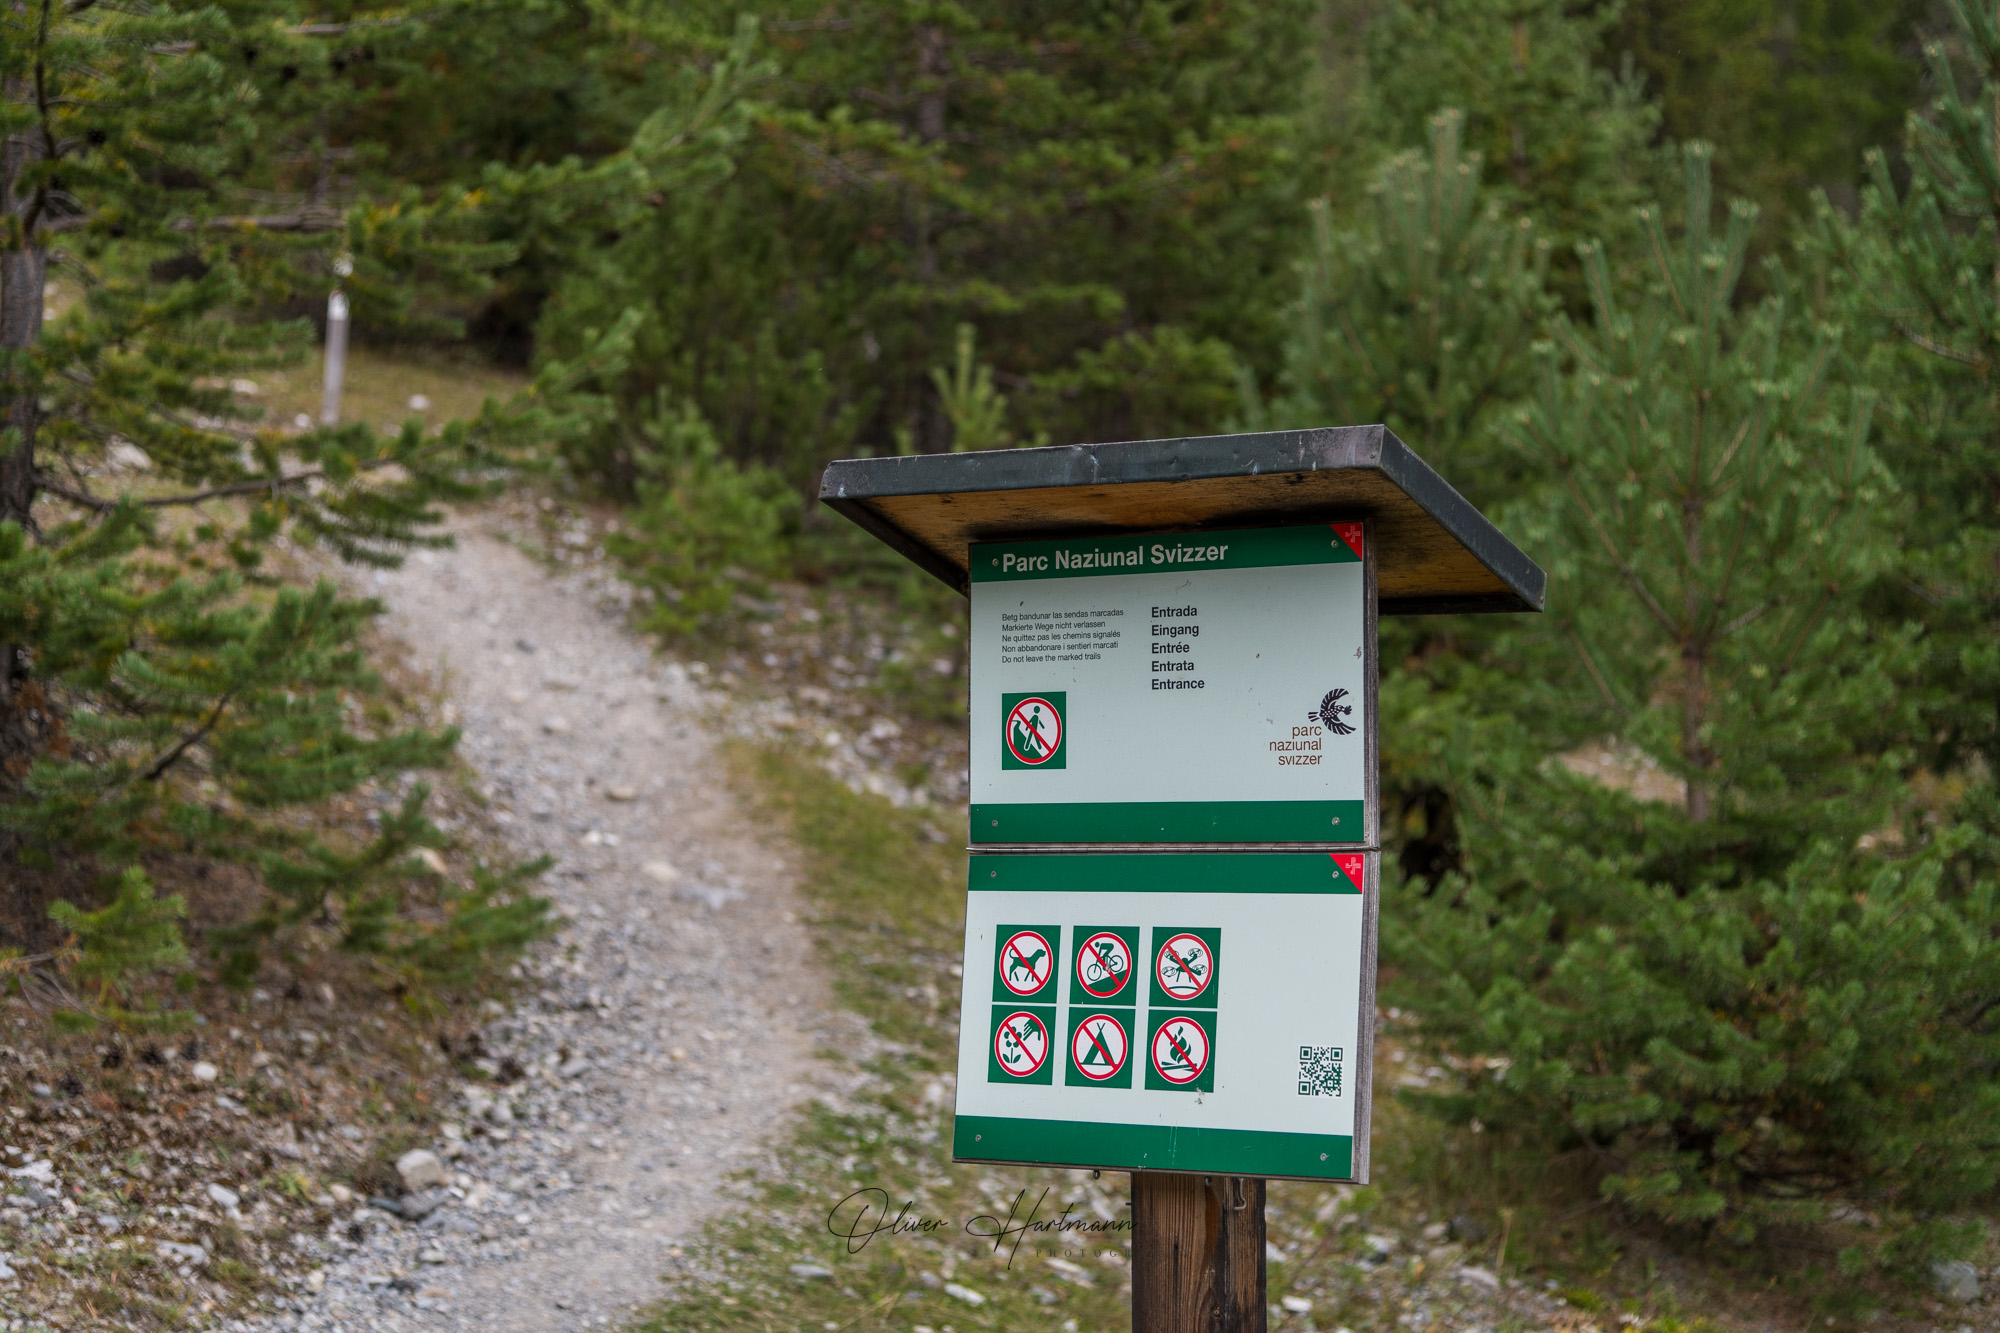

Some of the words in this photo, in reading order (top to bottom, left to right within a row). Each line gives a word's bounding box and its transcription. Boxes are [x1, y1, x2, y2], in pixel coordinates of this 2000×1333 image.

[1002, 553, 1048, 573] Parc
[1055, 546, 1144, 570] Naziunal
[1150, 543, 1229, 565] Svizzer
[1002, 613, 1018, 622] Betg
[1019, 612, 1051, 620] bandunar
[1052, 611, 1063, 619] las
[1064, 610, 1089, 619] sendas
[1090, 609, 1124, 617] marcadas
[1151, 605, 1198, 618] Entrada
[1002, 623, 1034, 631] Markierte
[1034, 622, 1054, 631] Wege
[1055, 621, 1072, 629] nicht
[1073, 620, 1106, 629] verlassen
[1151, 624, 1200, 638] Eingang
[1002, 634, 1012, 642] Ne
[1013, 633, 1036, 643] quittez
[1037, 634, 1050, 642] pas
[1051, 632, 1061, 640] les
[1062, 631, 1092, 640] chemins
[1092, 630, 1121, 640] signalés
[1002, 645, 1016, 653] Non
[1017, 643, 1062, 652] abbandonare
[1066, 641, 1092, 650] sentieri
[1093, 640, 1119, 649] marcati
[1151, 641, 1190, 654] Entrée
[1002, 655, 1012, 663] Do
[1013, 654, 1025, 663] not
[1025, 654, 1044, 662] leave
[1045, 653, 1056, 662] the
[1057, 652, 1083, 661] marked
[1084, 652, 1102, 660] trails
[1151, 660, 1195, 672] Entrata
[1151, 678, 1205, 690] Entrance
[1292, 725, 1322, 740] parc
[1269, 737, 1322, 751] naziunal
[1278, 754, 1323, 766] svizzer
